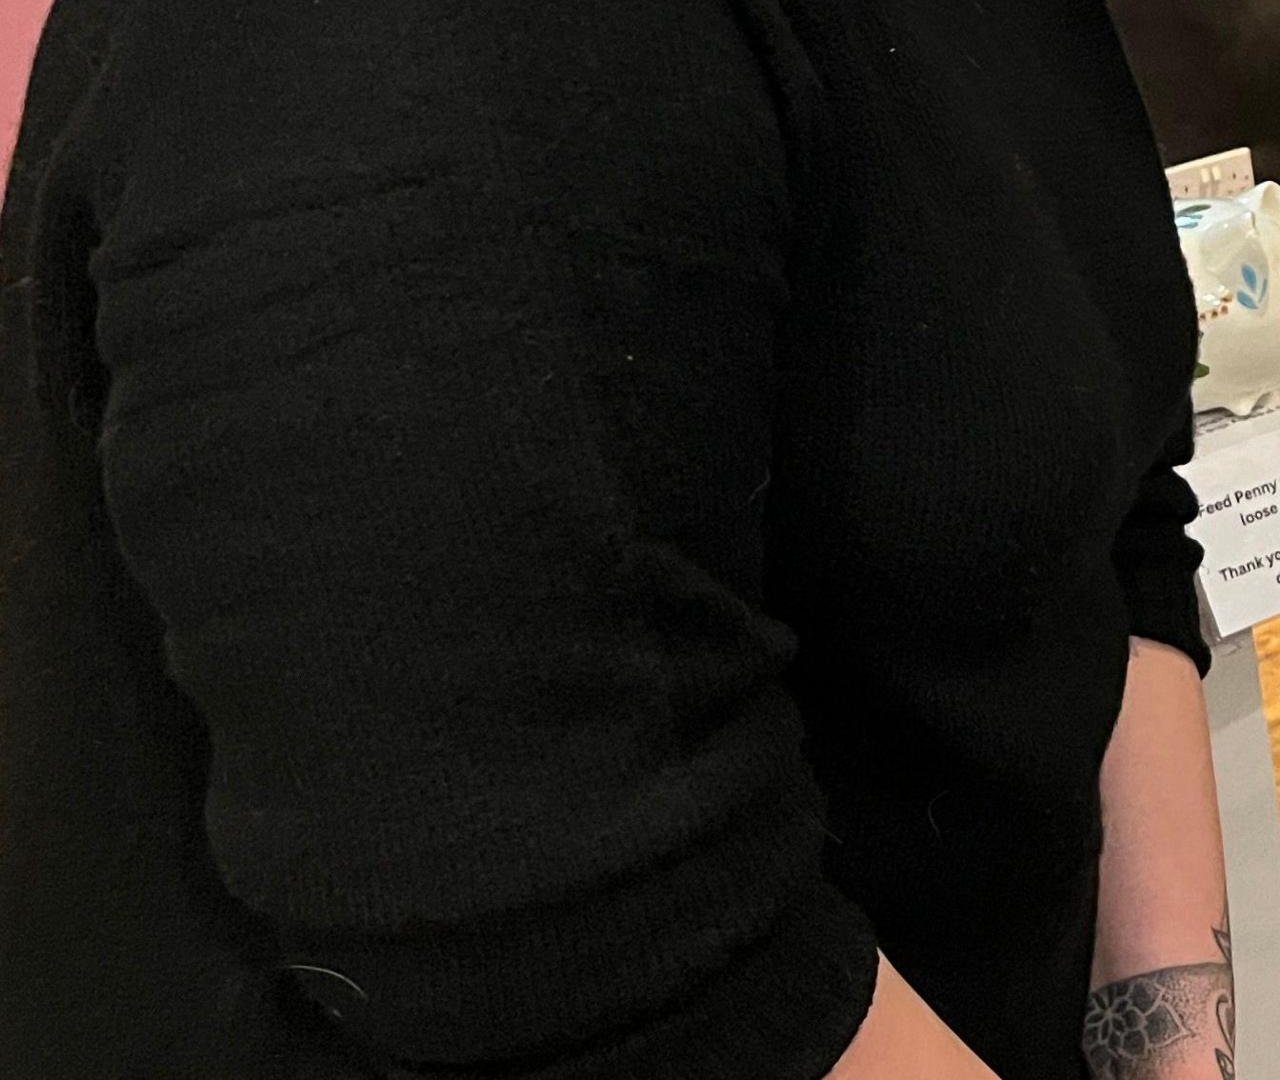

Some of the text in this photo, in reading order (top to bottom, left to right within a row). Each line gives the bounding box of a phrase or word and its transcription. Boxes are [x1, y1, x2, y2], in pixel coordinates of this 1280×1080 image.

[1200, 495, 1232, 517] Feed
[1234, 479, 1278, 504] Penny
[1240, 504, 1278, 526] loose
[1219, 556, 1264, 582] Thank
